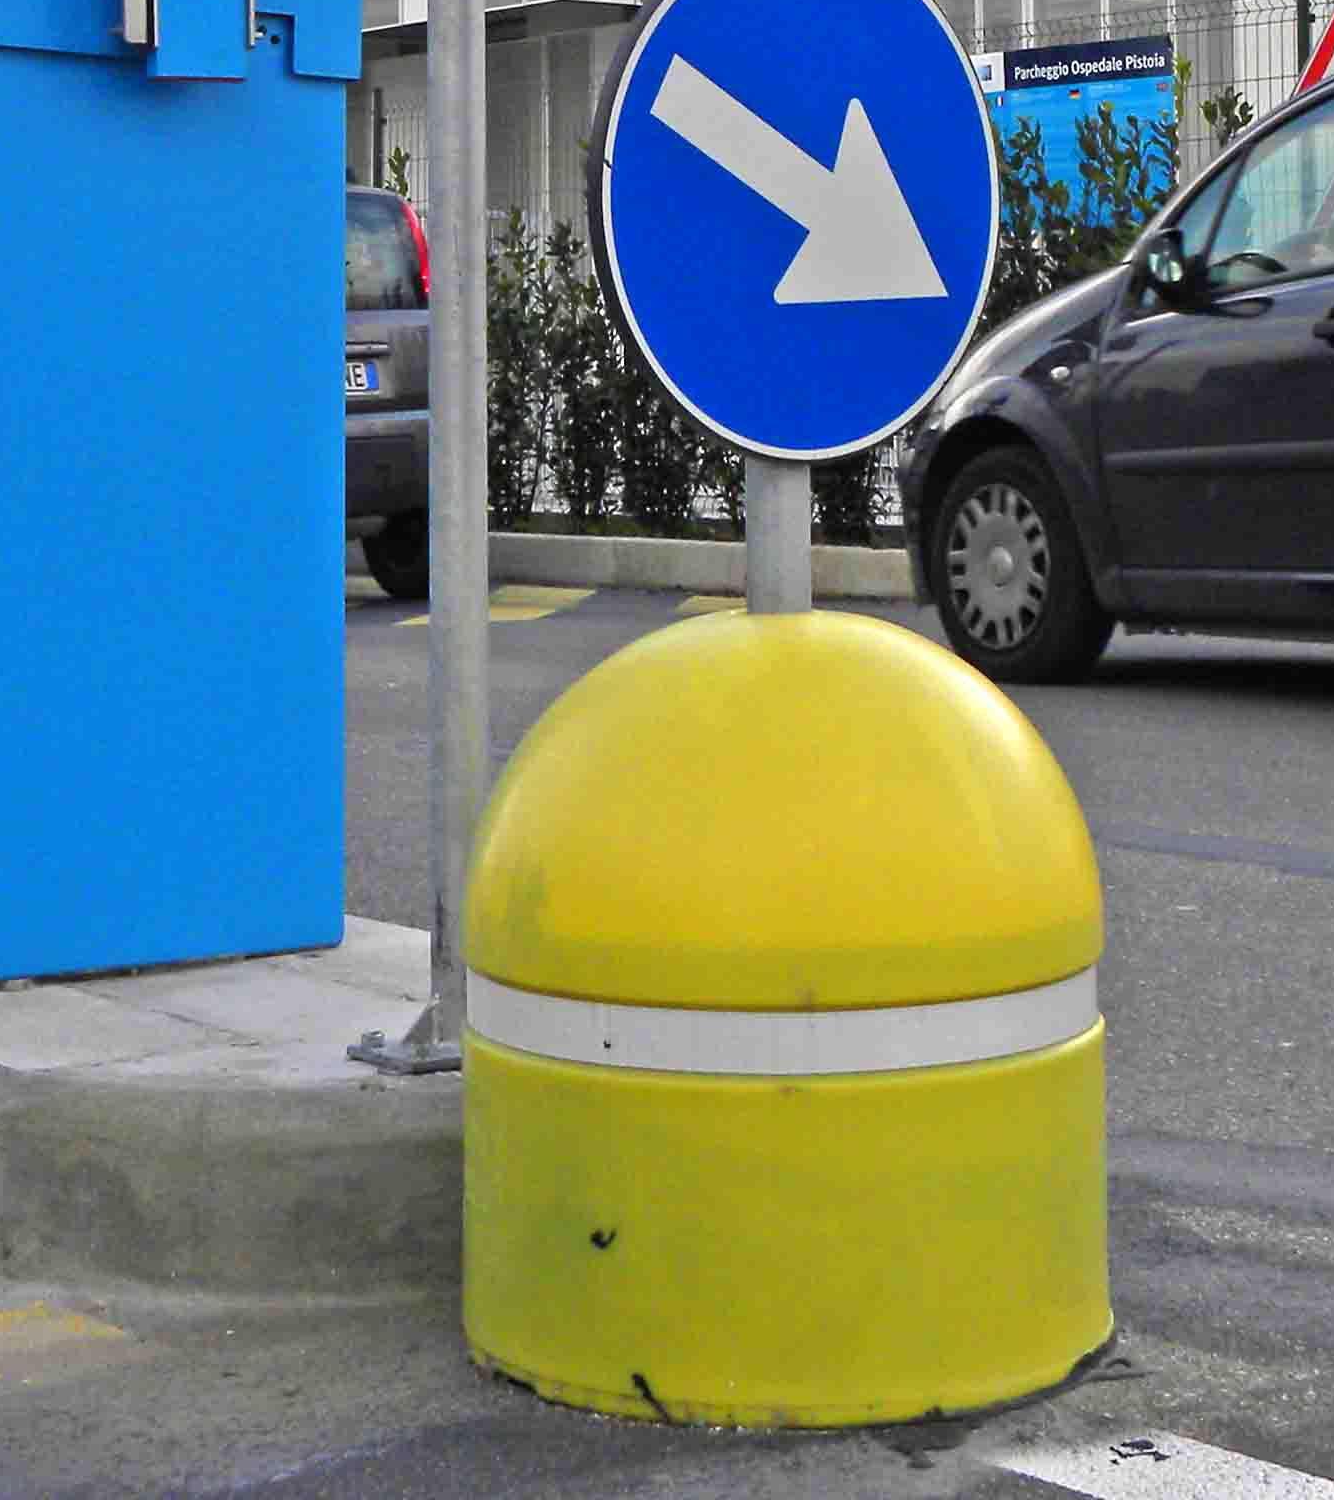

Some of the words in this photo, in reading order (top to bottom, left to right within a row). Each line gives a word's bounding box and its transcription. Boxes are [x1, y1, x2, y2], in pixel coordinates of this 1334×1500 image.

[1014, 61, 1068, 81] Parcheggio
[1070, 57, 1123, 77] Ospedale
[1125, 52, 1166, 70] Pistoia
